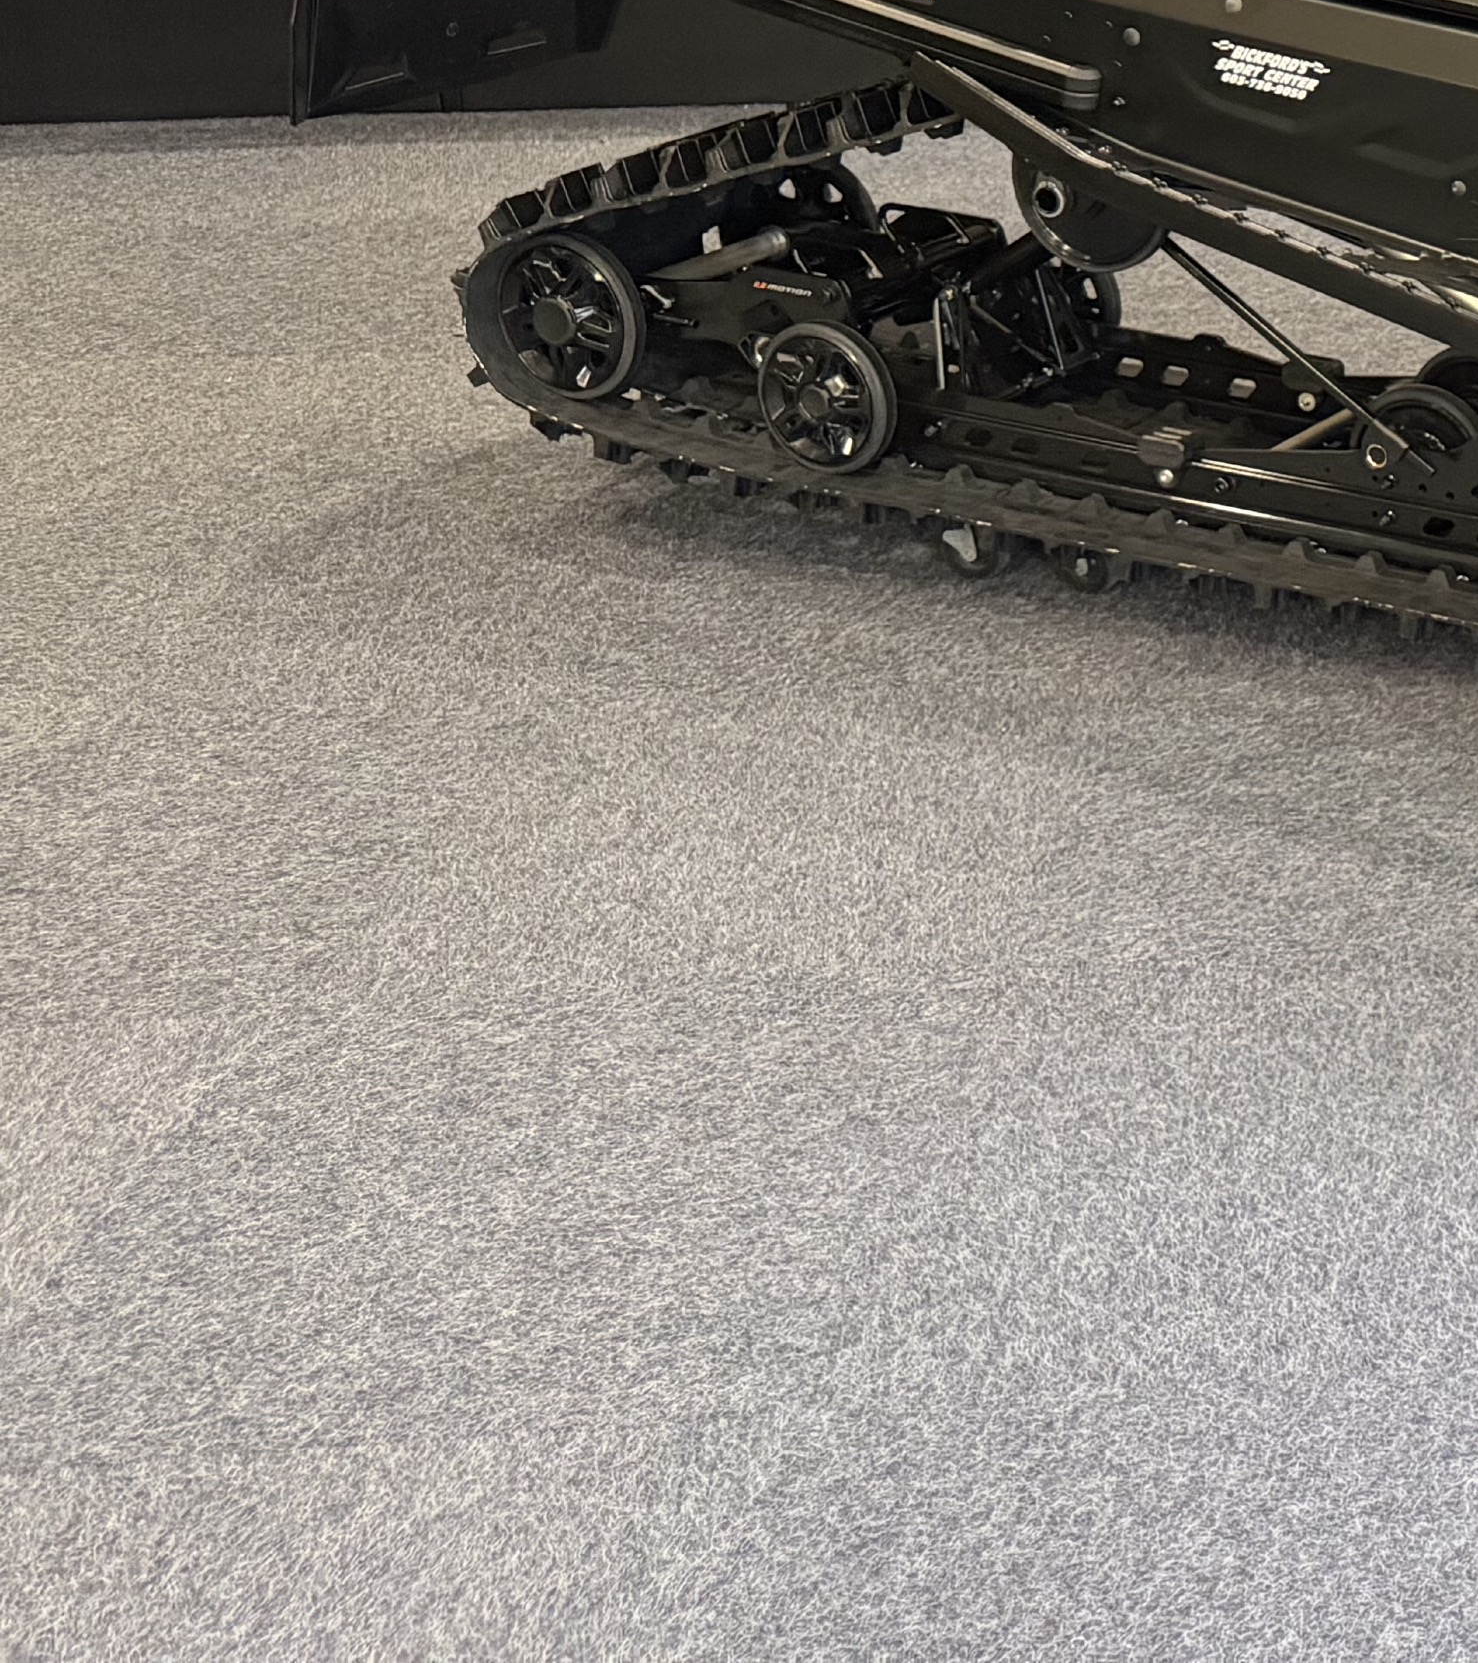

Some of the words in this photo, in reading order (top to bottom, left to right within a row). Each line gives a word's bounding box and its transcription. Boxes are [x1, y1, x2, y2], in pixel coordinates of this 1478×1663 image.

[1214, 57, 1265, 78] SPORT
[1263, 69, 1320, 92] CENTER
[1230, 45, 1309, 75] BICKFORD'S
